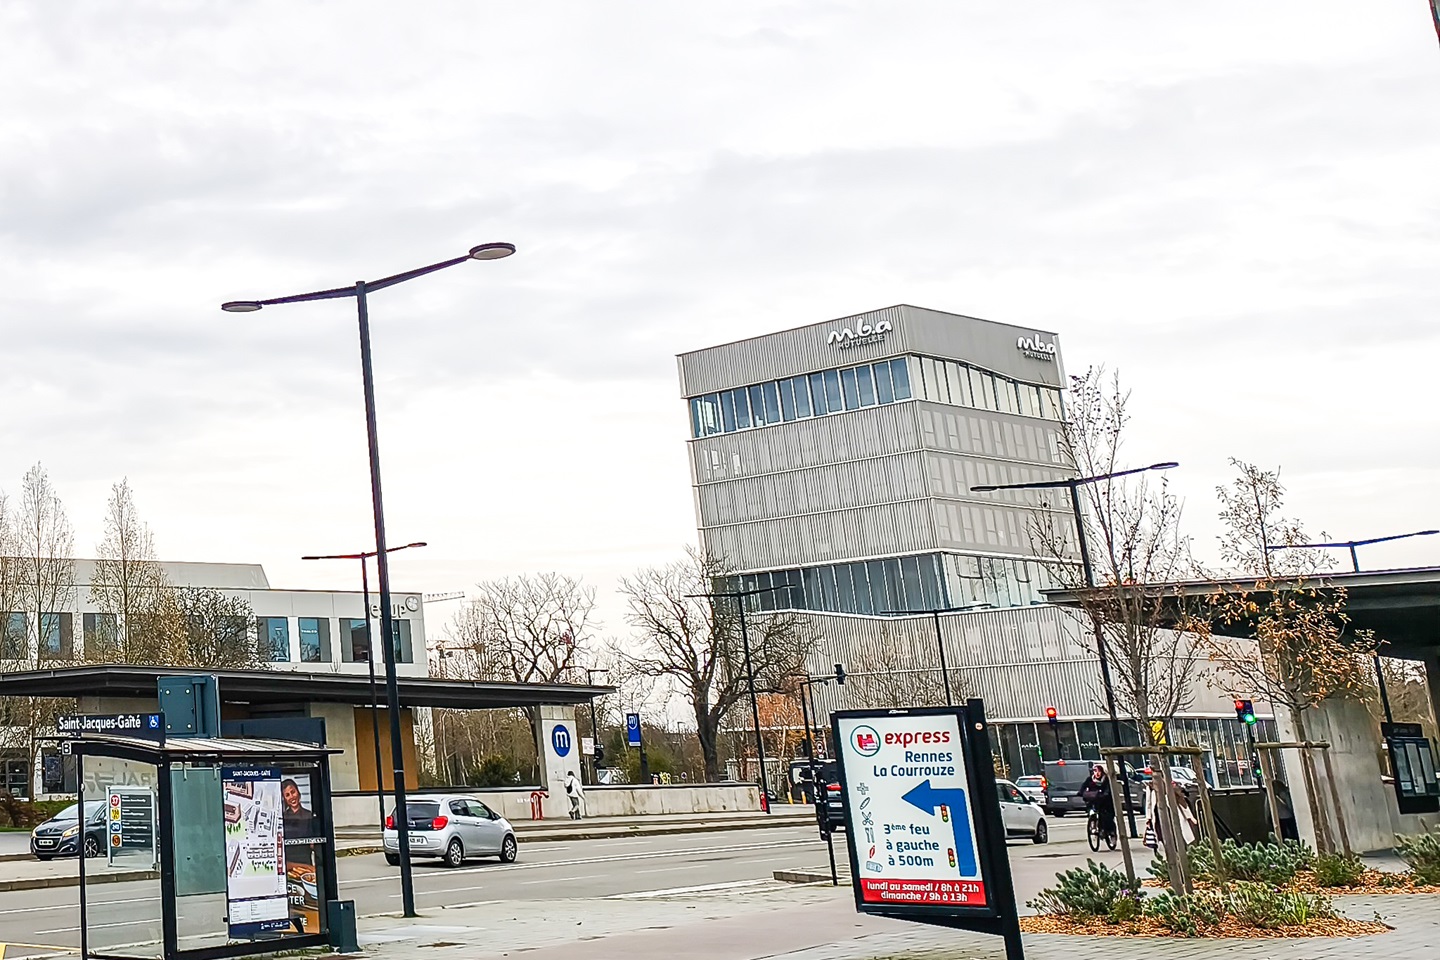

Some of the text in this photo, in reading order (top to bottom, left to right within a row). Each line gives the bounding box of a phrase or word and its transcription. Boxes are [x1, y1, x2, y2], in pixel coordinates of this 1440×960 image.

[58, 714, 141, 733] Saint-Jacques-Gaîté
[885, 731, 951, 748] express
[905, 751, 953, 762] Rennes
[873, 765, 955, 777] La Courrouze
[883, 823, 930, 835] 3ème feu
[886, 839, 940, 852] à gauche
[888, 855, 934, 866] à 500m
[867, 881, 888, 891] lundi
[902, 882, 933, 892] samedi
[941, 883, 952, 892] 8h
[954, 883, 960, 892] à
[962, 883, 979, 893] 21h
[881, 891, 922, 901] dimanche
[929, 892, 941, 901] 9h
[942, 891, 948, 901] à
[951, 893, 968, 902] 13h
